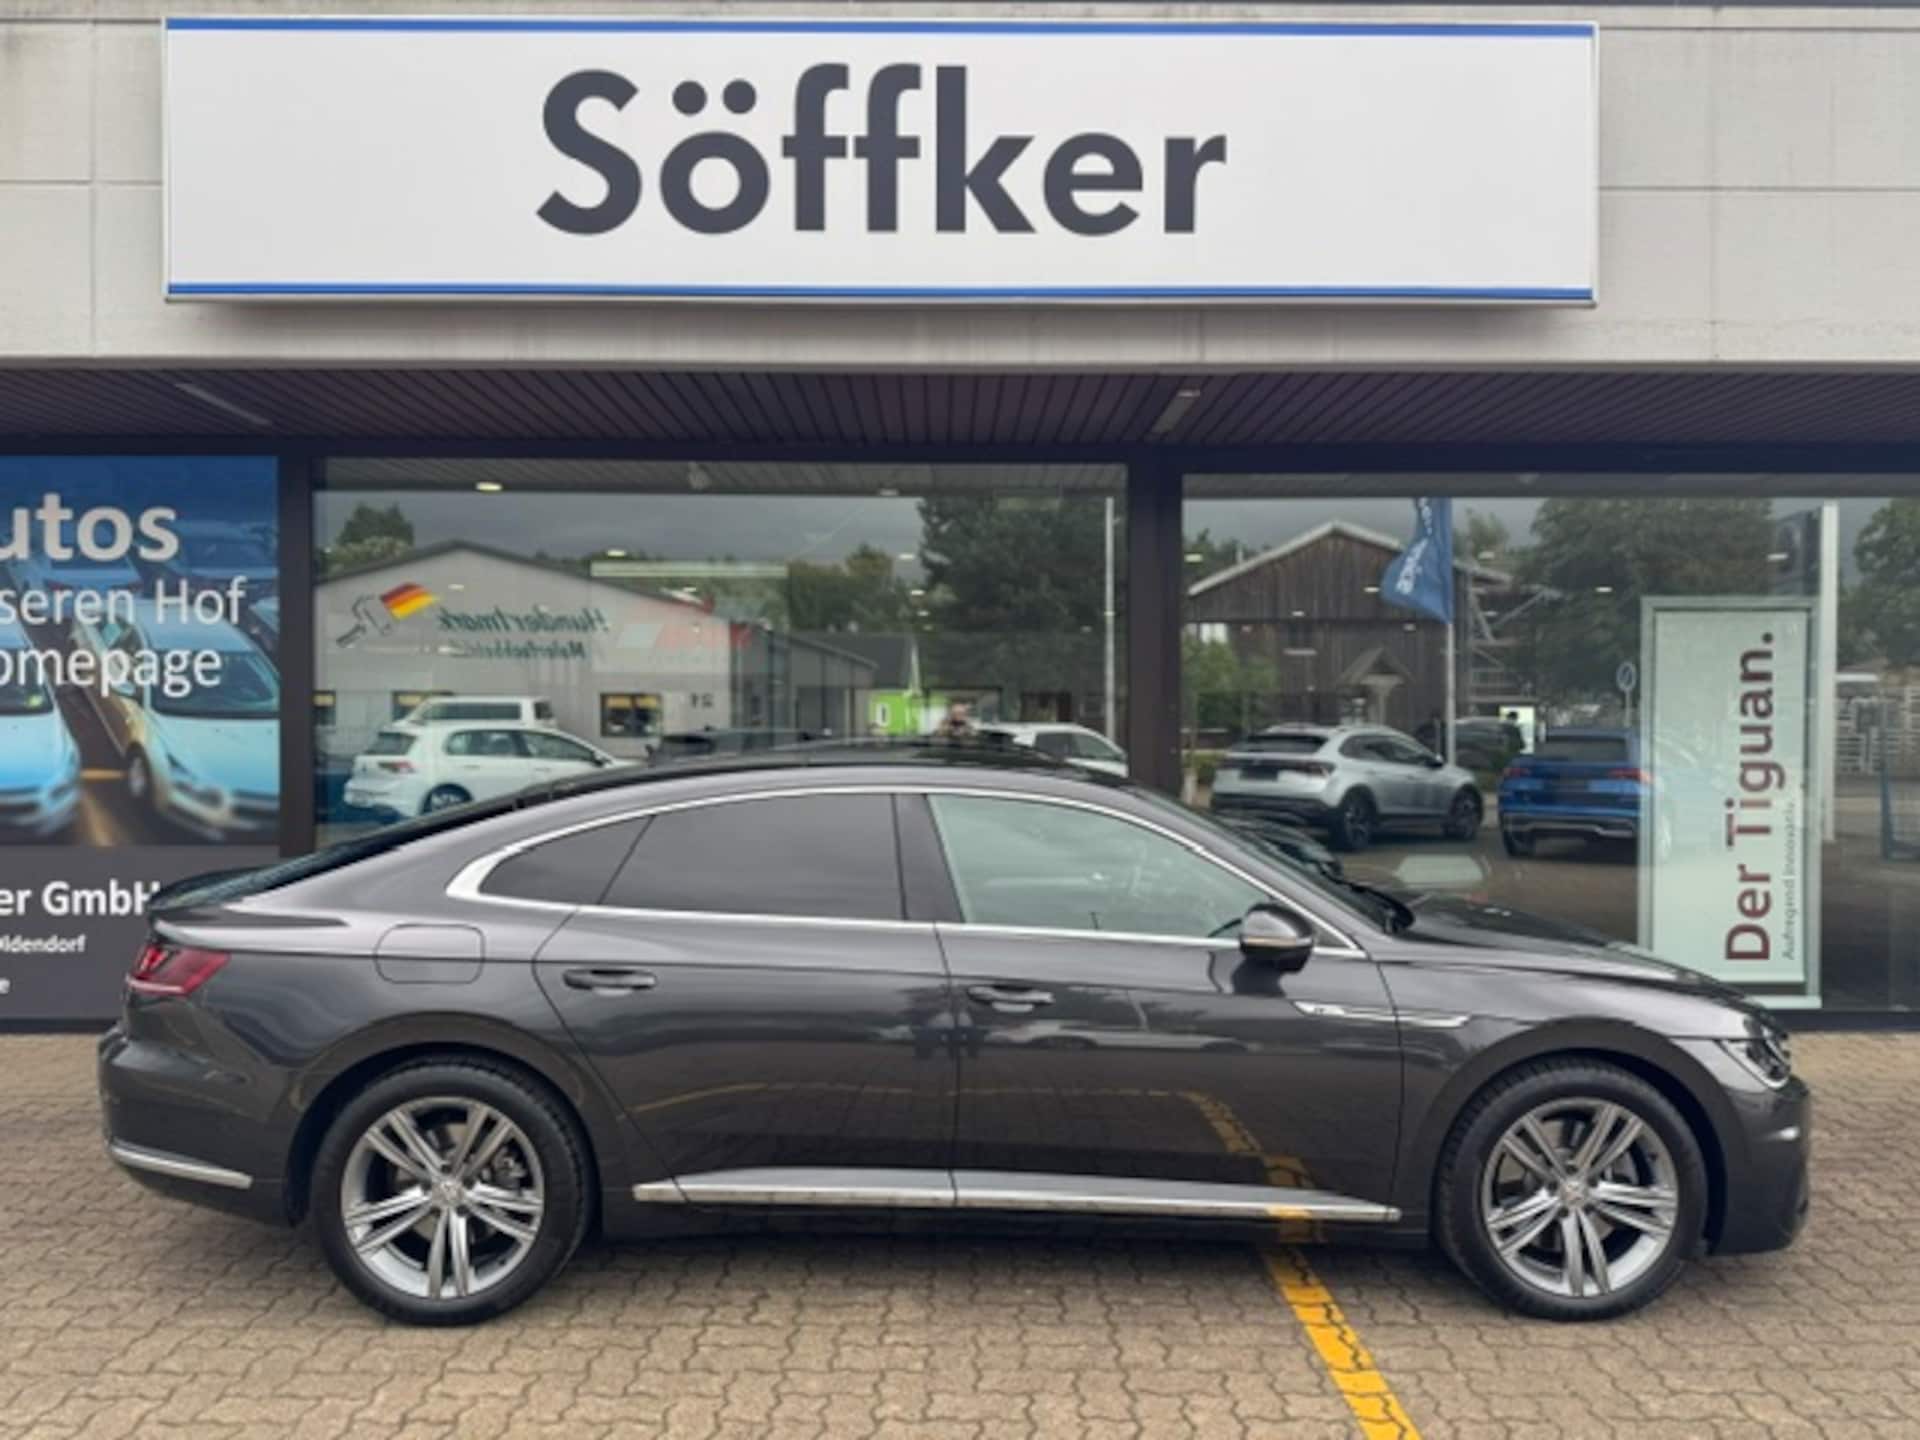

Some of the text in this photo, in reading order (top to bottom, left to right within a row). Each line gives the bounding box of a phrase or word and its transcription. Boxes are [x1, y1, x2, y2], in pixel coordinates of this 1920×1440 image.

[536, 63, 1227, 236] Söffker
[0, 492, 180, 562] utos
[0, 575, 248, 625] seren Hof
[1724, 631, 1786, 961] Der Tiguan.
[0, 878, 161, 916] er GmbH
